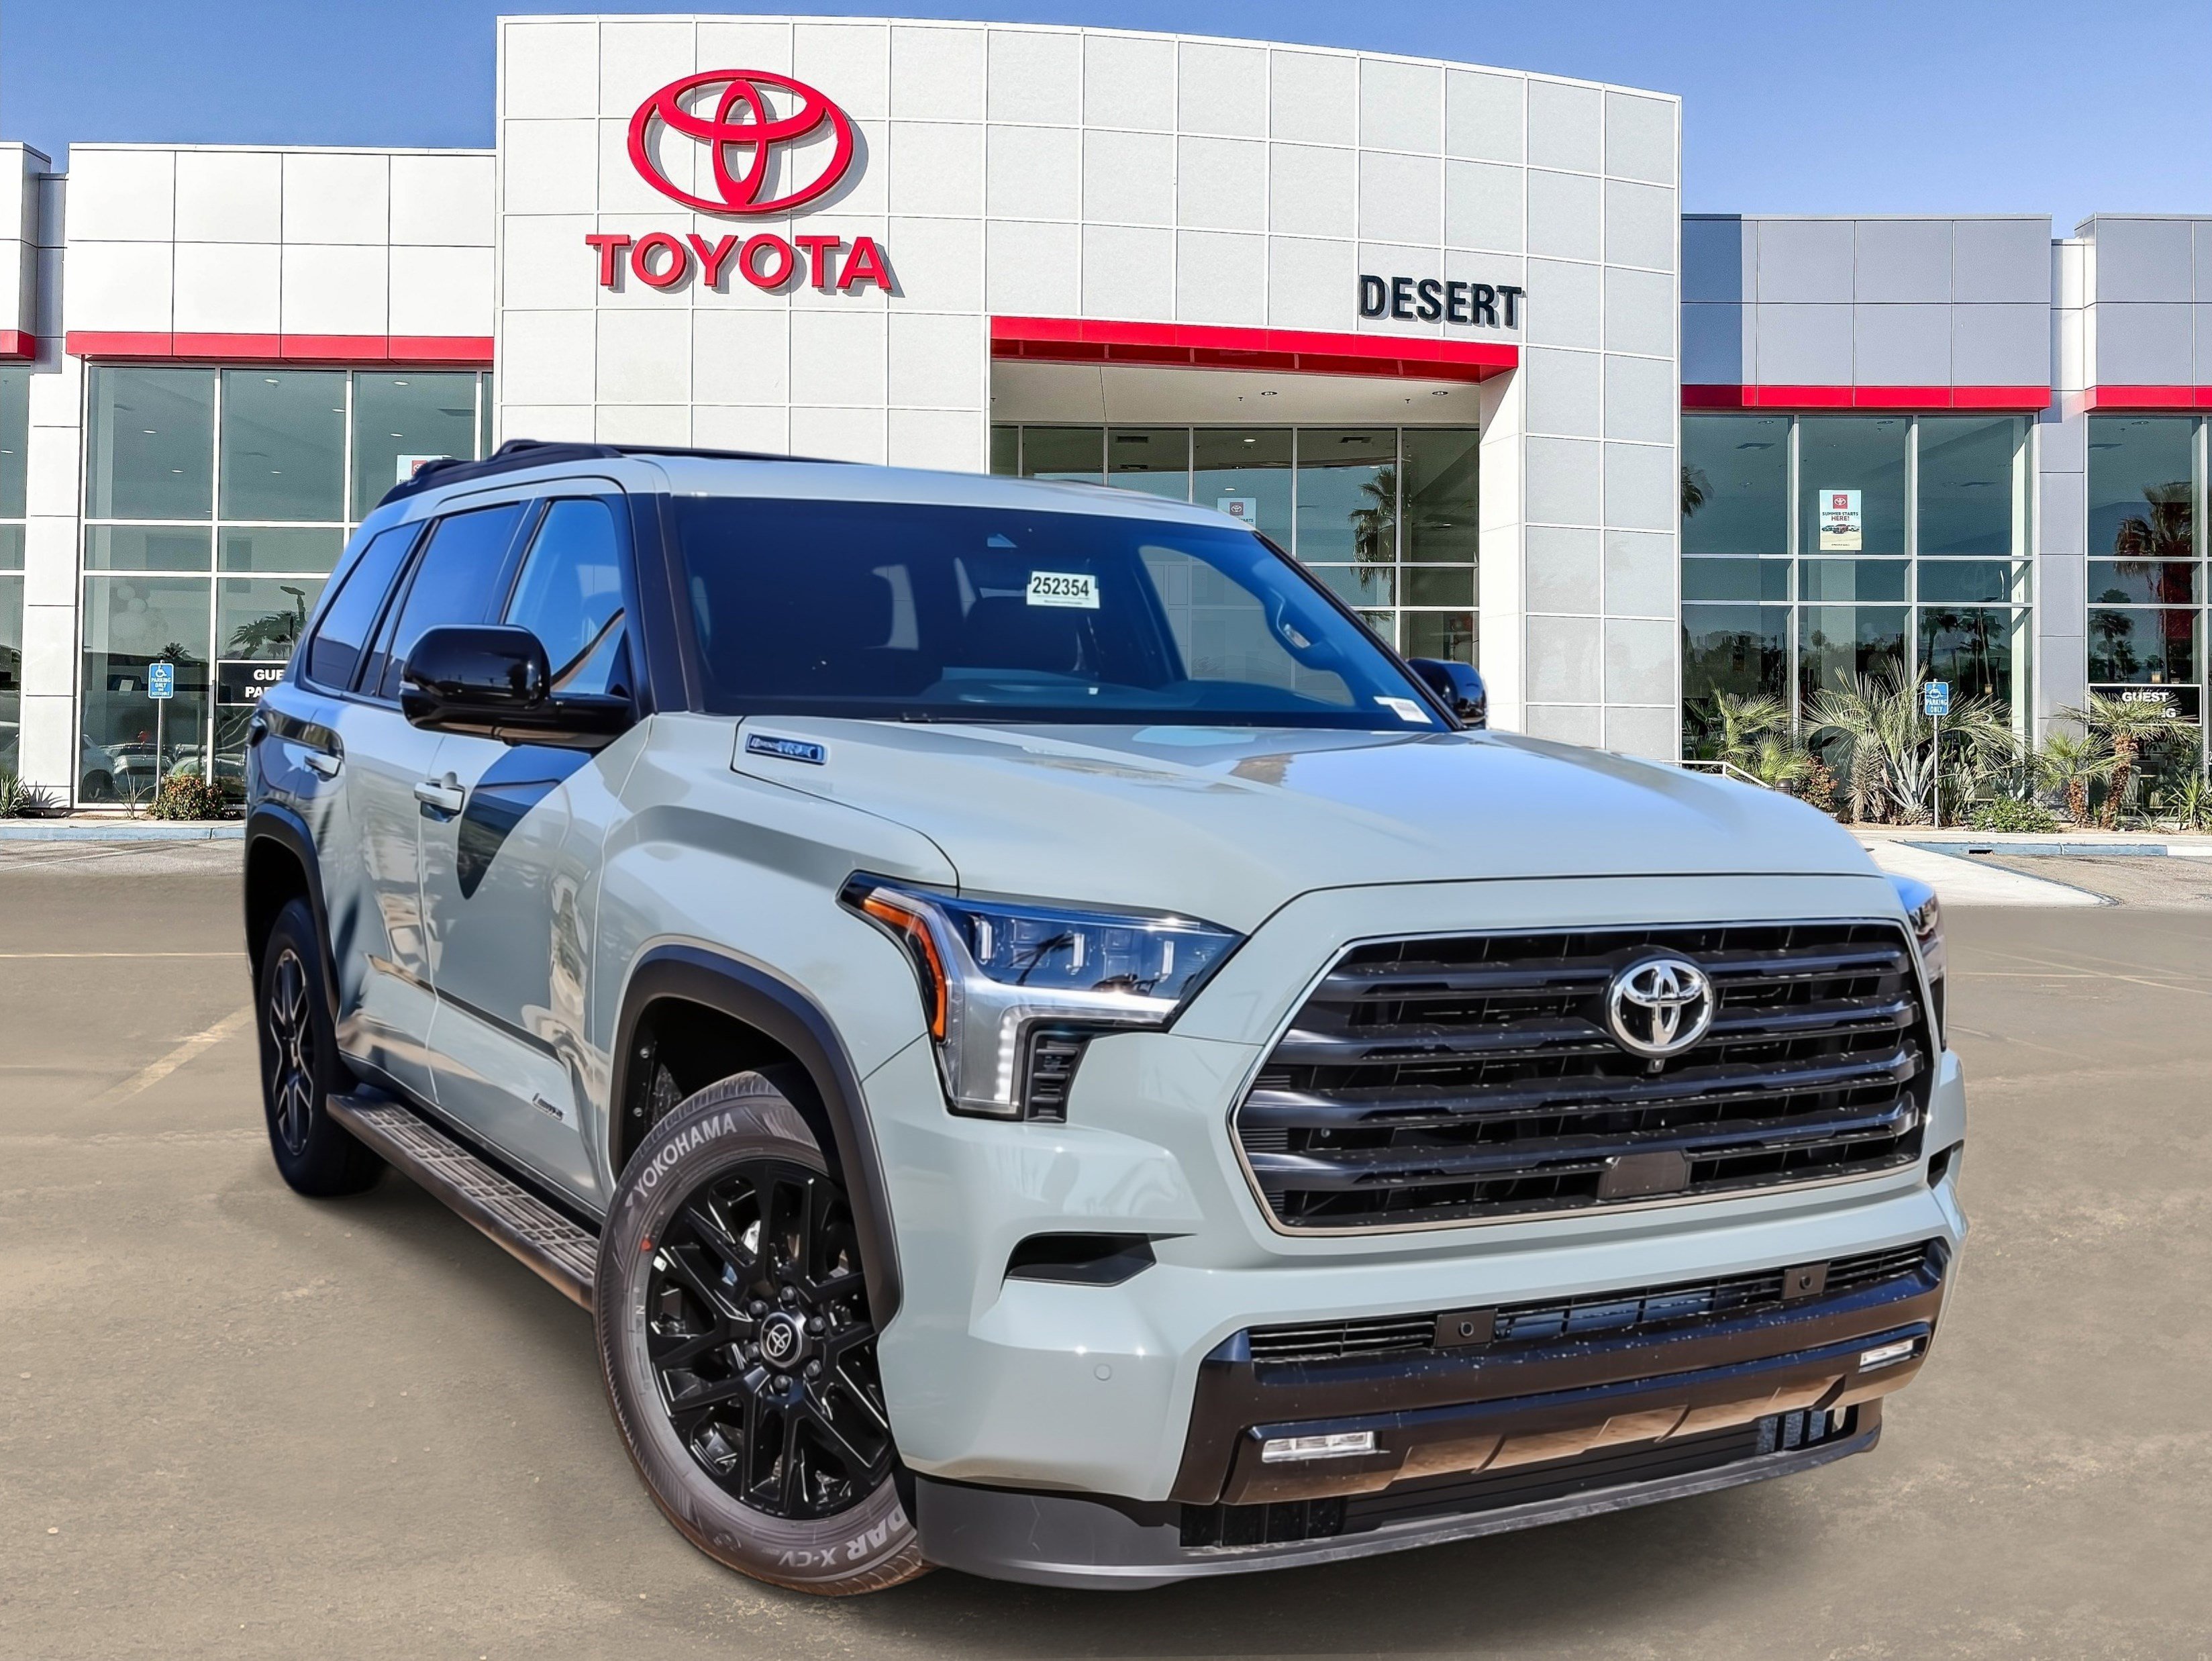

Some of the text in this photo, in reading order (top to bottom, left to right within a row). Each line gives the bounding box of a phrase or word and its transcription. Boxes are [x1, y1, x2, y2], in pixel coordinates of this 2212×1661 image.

[586, 232, 893, 291] TOYOTA
[1359, 274, 1522, 327] DESERT
[1032, 576, 1089, 597] 252354
[253, 668, 285, 681] GUE
[1930, 705, 1943, 713] ONLY
[2121, 691, 2169, 702] GUEST
[634, 1113, 737, 1197] YOKOHAMA
[846, 1505, 908, 1560] DAR
